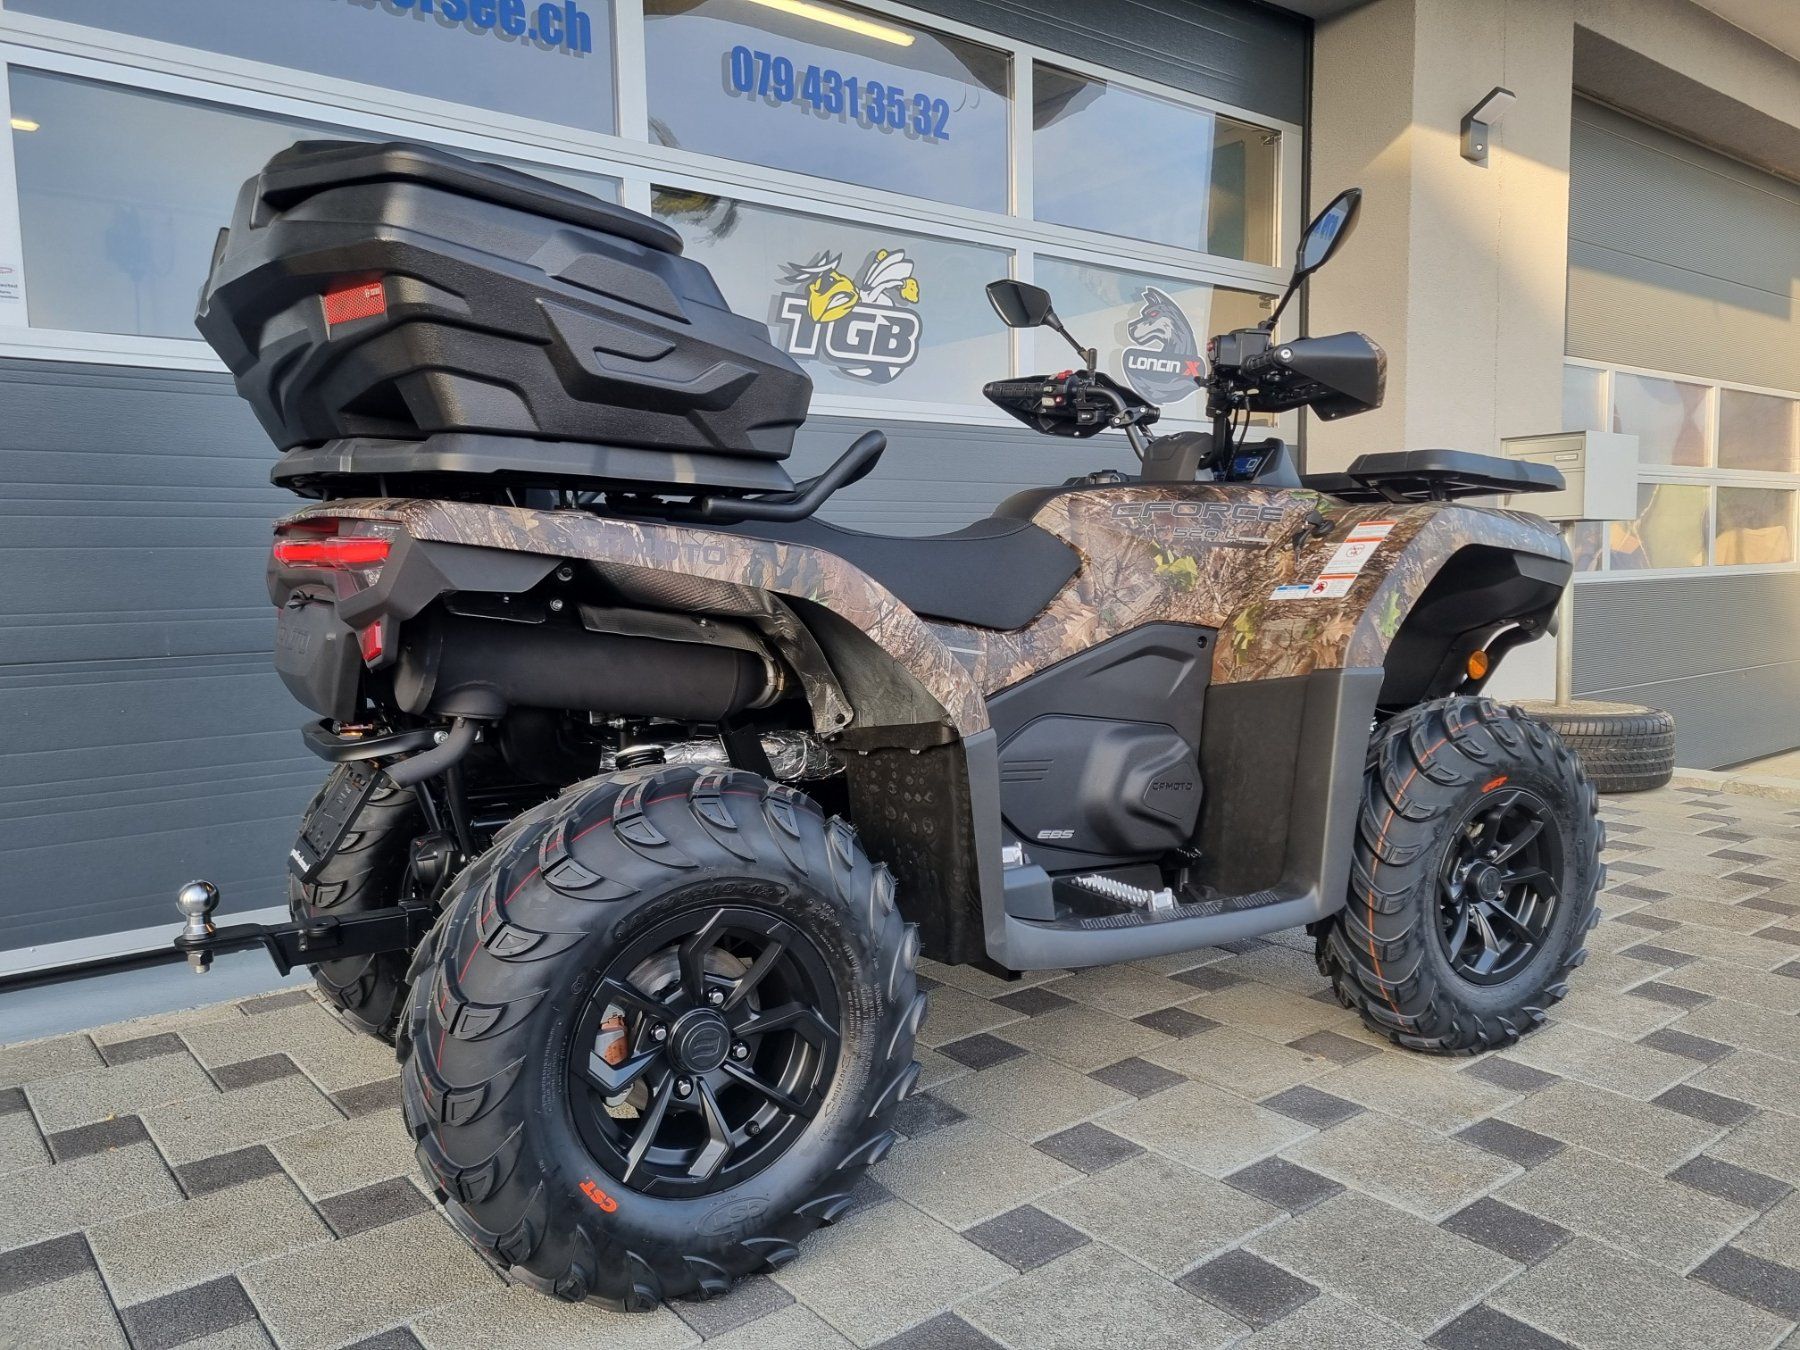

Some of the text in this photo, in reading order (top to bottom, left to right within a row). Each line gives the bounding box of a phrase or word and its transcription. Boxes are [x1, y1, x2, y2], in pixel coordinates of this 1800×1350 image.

[731, 45, 949, 140] 079 431 35 32
[782, 297, 920, 364] TGB
[1128, 356, 1200, 377] LONCIN X
[1111, 502, 1285, 522] CFORCE
[1173, 527, 1218, 539] 520
[1152, 782, 1193, 791] CFMOTO
[1037, 829, 1074, 839] EBS
[579, 1180, 618, 1214] CST
